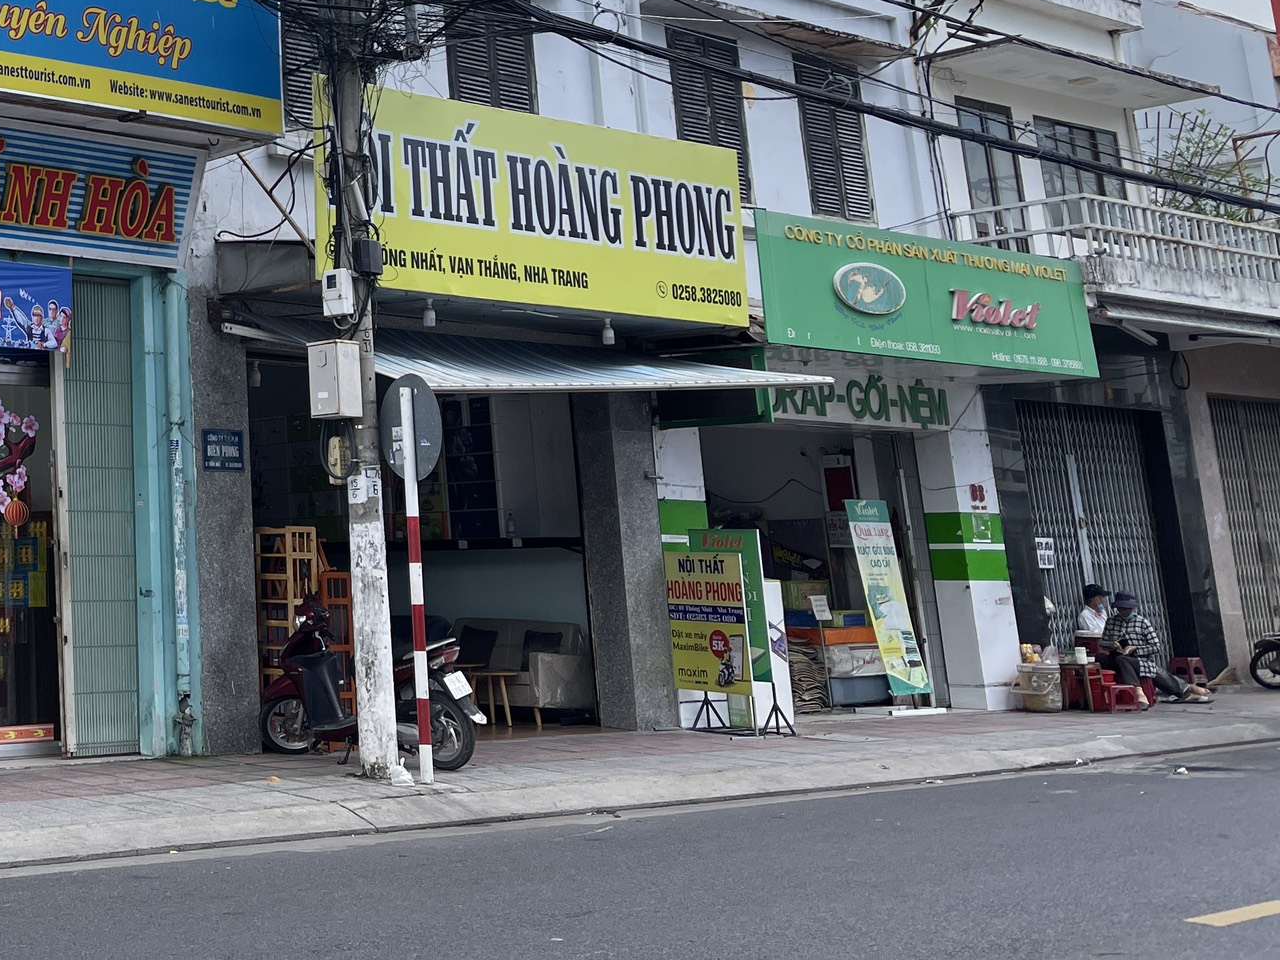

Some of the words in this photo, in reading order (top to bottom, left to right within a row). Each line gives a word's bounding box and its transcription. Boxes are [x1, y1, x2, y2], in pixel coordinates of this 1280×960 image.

[76, 6, 193, 71] Nghiệp
[109, 78, 148, 100] Website:
[149, 86, 262, 119] www.sanesttourist.com.vn
[79, 155, 178, 244] HÒA
[403, 121, 498, 227] THẤT
[506, 143, 623, 246] HOÀNG
[629, 174, 738, 261] PHONG
[410, 247, 447, 274] NHẤT,
[448, 259, 476, 280] VẠN
[479, 254, 521, 283] THẮNG,
[524, 265, 549, 285] NHA
[550, 268, 589, 289] TRANG
[784, 224, 823, 244] CÔNG
[824, 231, 843, 248] TY
[846, 231, 866, 250] CỔ
[1010, 260, 1030, 278] MẠI
[1032, 264, 1067, 282] VIOLET
[671, 283, 742, 307] 0258.3825080
[950, 288, 1040, 330] Violet
[702, 533, 743, 549] Violet
[678, 555, 695, 577] NỘI
[698, 553, 725, 574] THẤT
[667, 577, 703, 601] HOÀNG
[705, 581, 743, 602] PHONG
[673, 642, 708, 653] MaximBike
[678, 667, 708, 678] maxim
